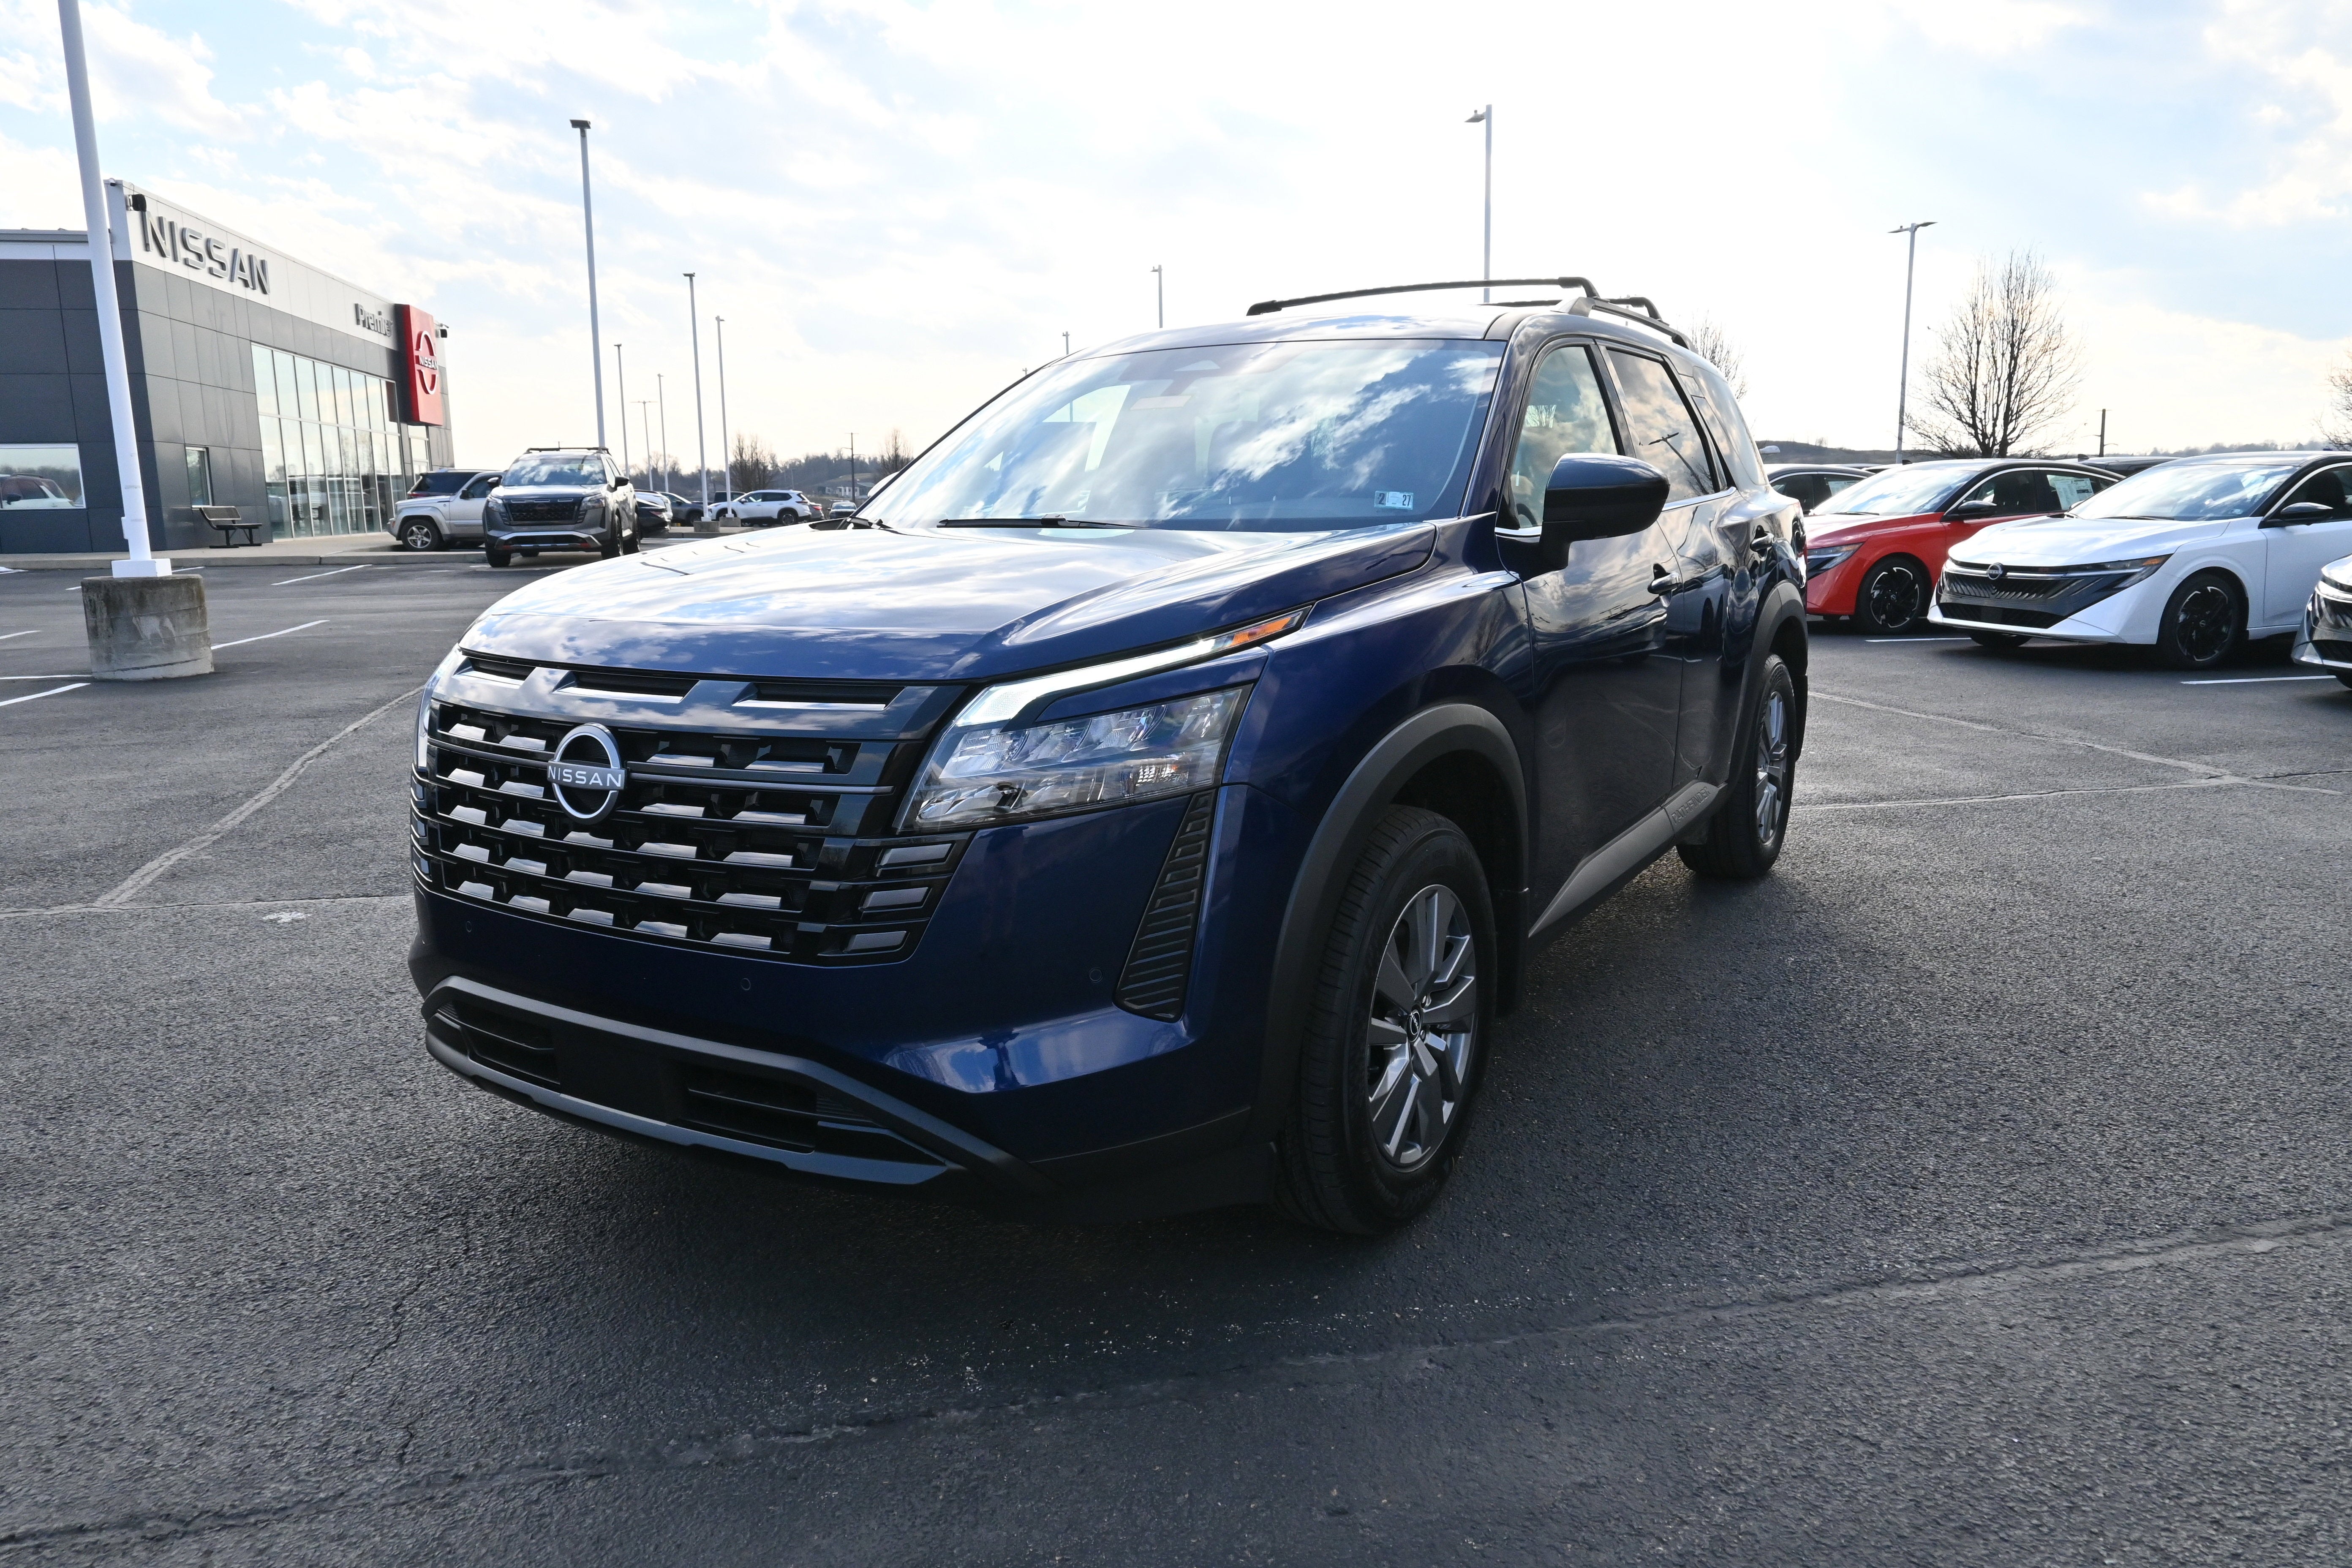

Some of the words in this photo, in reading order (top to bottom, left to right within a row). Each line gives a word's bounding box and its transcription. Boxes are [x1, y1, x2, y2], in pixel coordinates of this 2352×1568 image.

[140, 210, 270, 294] NISSAN
[354, 303, 393, 337] Premier
[418, 355, 438, 370] NISSAN
[1378, 493, 1386, 505] 2
[1402, 494, 1411, 506] 27
[548, 765, 621, 787] NISSAN
[1671, 786, 1711, 825] PATHFINDER
